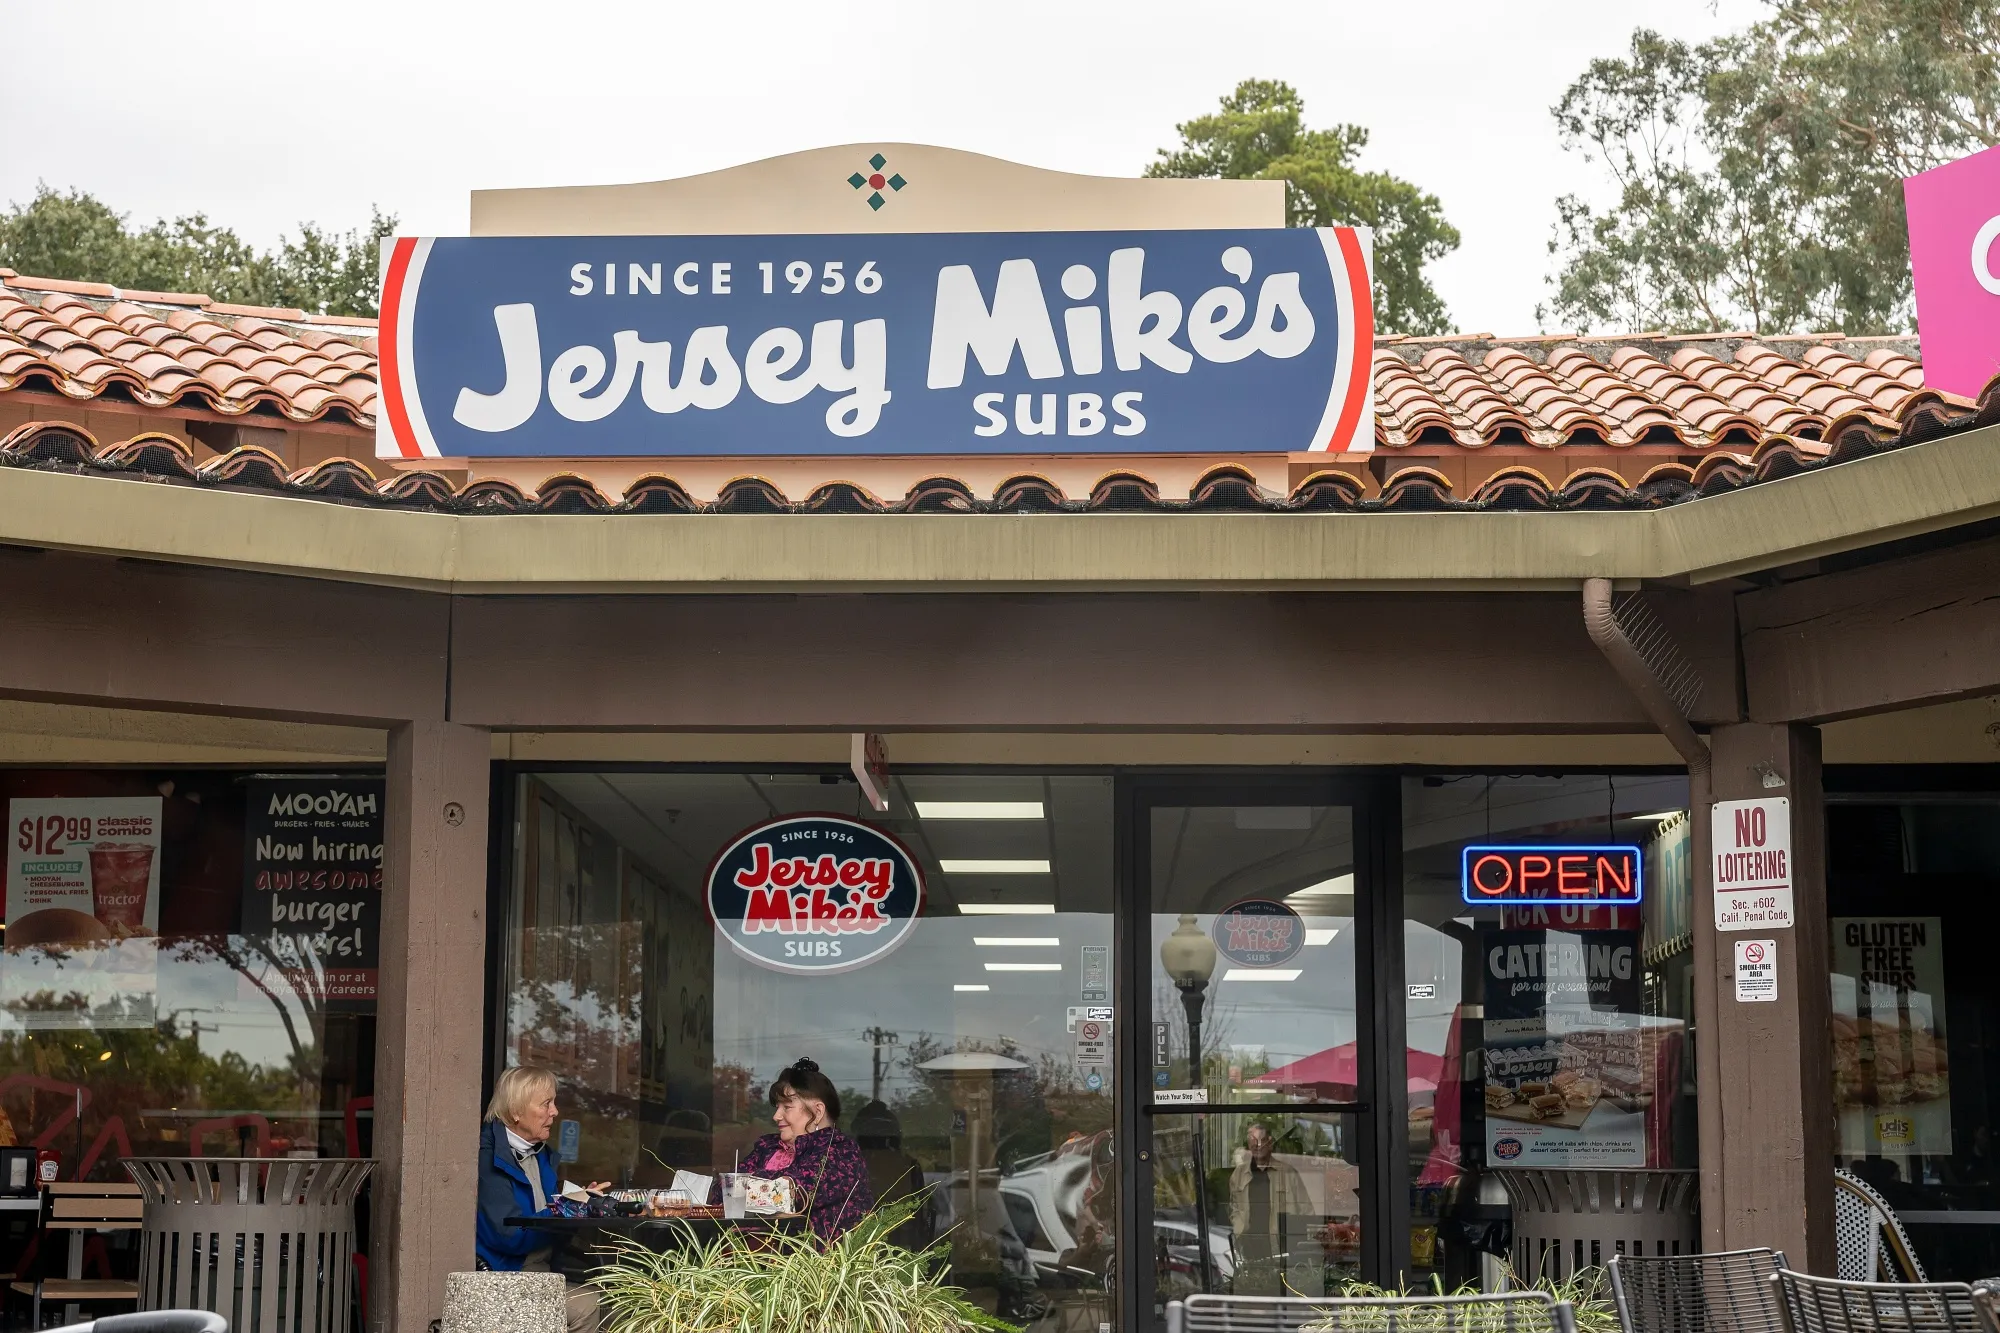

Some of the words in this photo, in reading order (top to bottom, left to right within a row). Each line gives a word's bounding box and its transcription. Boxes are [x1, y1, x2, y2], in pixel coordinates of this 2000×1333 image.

[569, 262, 733, 297] SINCE
[757, 260, 884, 296] 1956
[452, 302, 891, 438] Jersey
[925, 246, 1317, 391] Mike's
[972, 391, 1148, 438] SUBS
[267, 789, 377, 817] MOOYAH
[97, 815, 153, 826] classic
[97, 826, 153, 836] combo
[274, 820, 308, 828] BURGERS
[314, 820, 335, 828] FRIES
[341, 820, 370, 828] SHAKES
[1734, 806, 1767, 848] NO
[781, 830, 818, 843] SINCE
[824, 830, 855, 844] 1956
[256, 834, 304, 862] Now
[312, 835, 384, 869] hiring
[24, 863, 80, 872] INCLUDES
[735, 845, 893, 900] Jersey
[1473, 855, 1631, 894] OPEN
[1717, 849, 1787, 882] LOITERING
[255, 869, 383, 891] awesome
[98, 894, 142, 906] tractor
[1560, 887, 1601, 924] UP
[1731, 899, 1750, 911] Sec.
[1753, 897, 1776, 909] #602
[271, 893, 366, 931] burger
[743, 889, 889, 935] Mike's
[1721, 911, 1742, 923] Calif.
[1744, 910, 1766, 922] Penal
[1767, 909, 1788, 921] Code
[1225, 910, 1293, 938] Jersey
[1845, 923, 1926, 947] GLUTEN
[784, 940, 842, 957] SUBS
[1228, 930, 1292, 952] Mike's
[1246, 954, 1271, 962] SUBS
[1489, 944, 1632, 980] CATERING
[1739, 963, 1772, 971] SMOKE-FREE
[1861, 947, 1914, 971] FREE
[265, 972, 301, 984] Apply
[339, 974, 352, 982] or
[354, 973, 366, 982] at
[1749, 970, 1763, 978] AREA
[1511, 981, 1532, 997] for
[1532, 983, 1557, 999] any
[1557, 979, 1612, 993] occasion!
[1157, 1025, 1166, 1065] PULL
[1498, 1056, 1553, 1076] Jersey
[1155, 1093, 1170, 1101] Watch
[1182, 1093, 1193, 1101] Step
